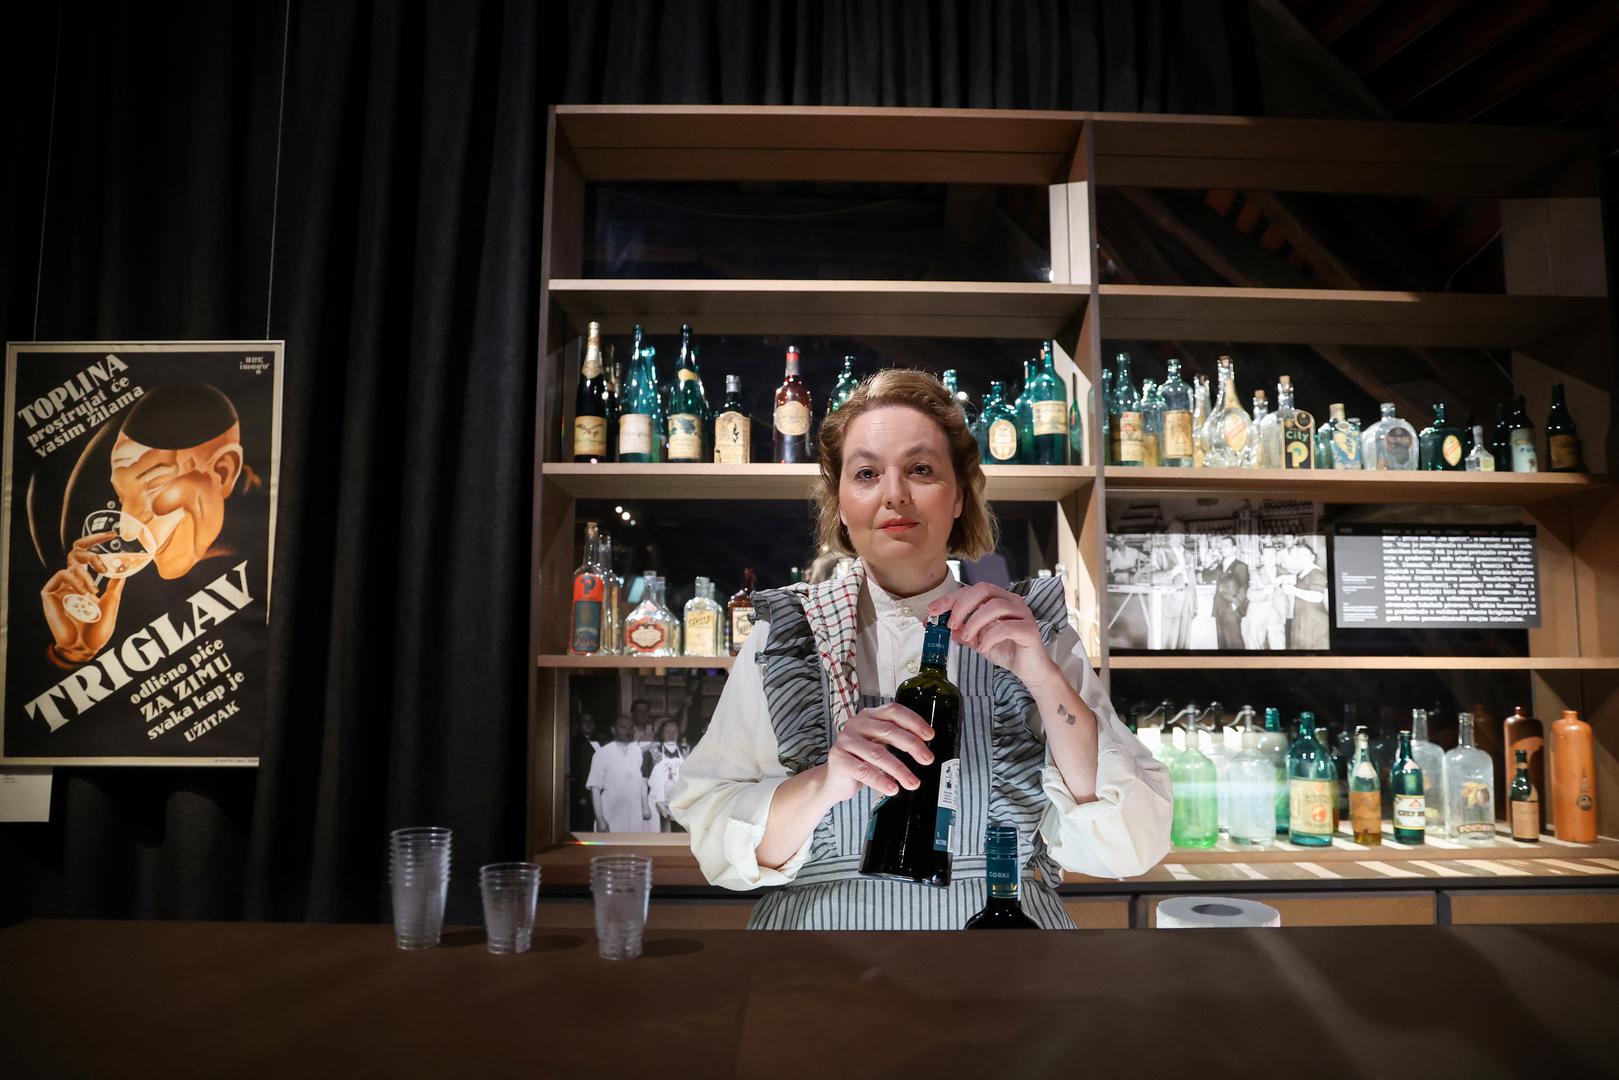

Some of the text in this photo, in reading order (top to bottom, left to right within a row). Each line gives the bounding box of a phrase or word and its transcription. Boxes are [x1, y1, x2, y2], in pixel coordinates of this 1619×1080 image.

[17, 354, 128, 428] TOPLINA
[27, 377, 130, 448] prostrujat će
[1286, 430, 1309, 442] City
[24, 560, 254, 733] TRIGLAV
[190, 639, 224, 669] piće
[140, 653, 232, 722] ZA ZIMU
[147, 672, 245, 740] svaka kap je
[184, 700, 240, 742] UŽITAK
